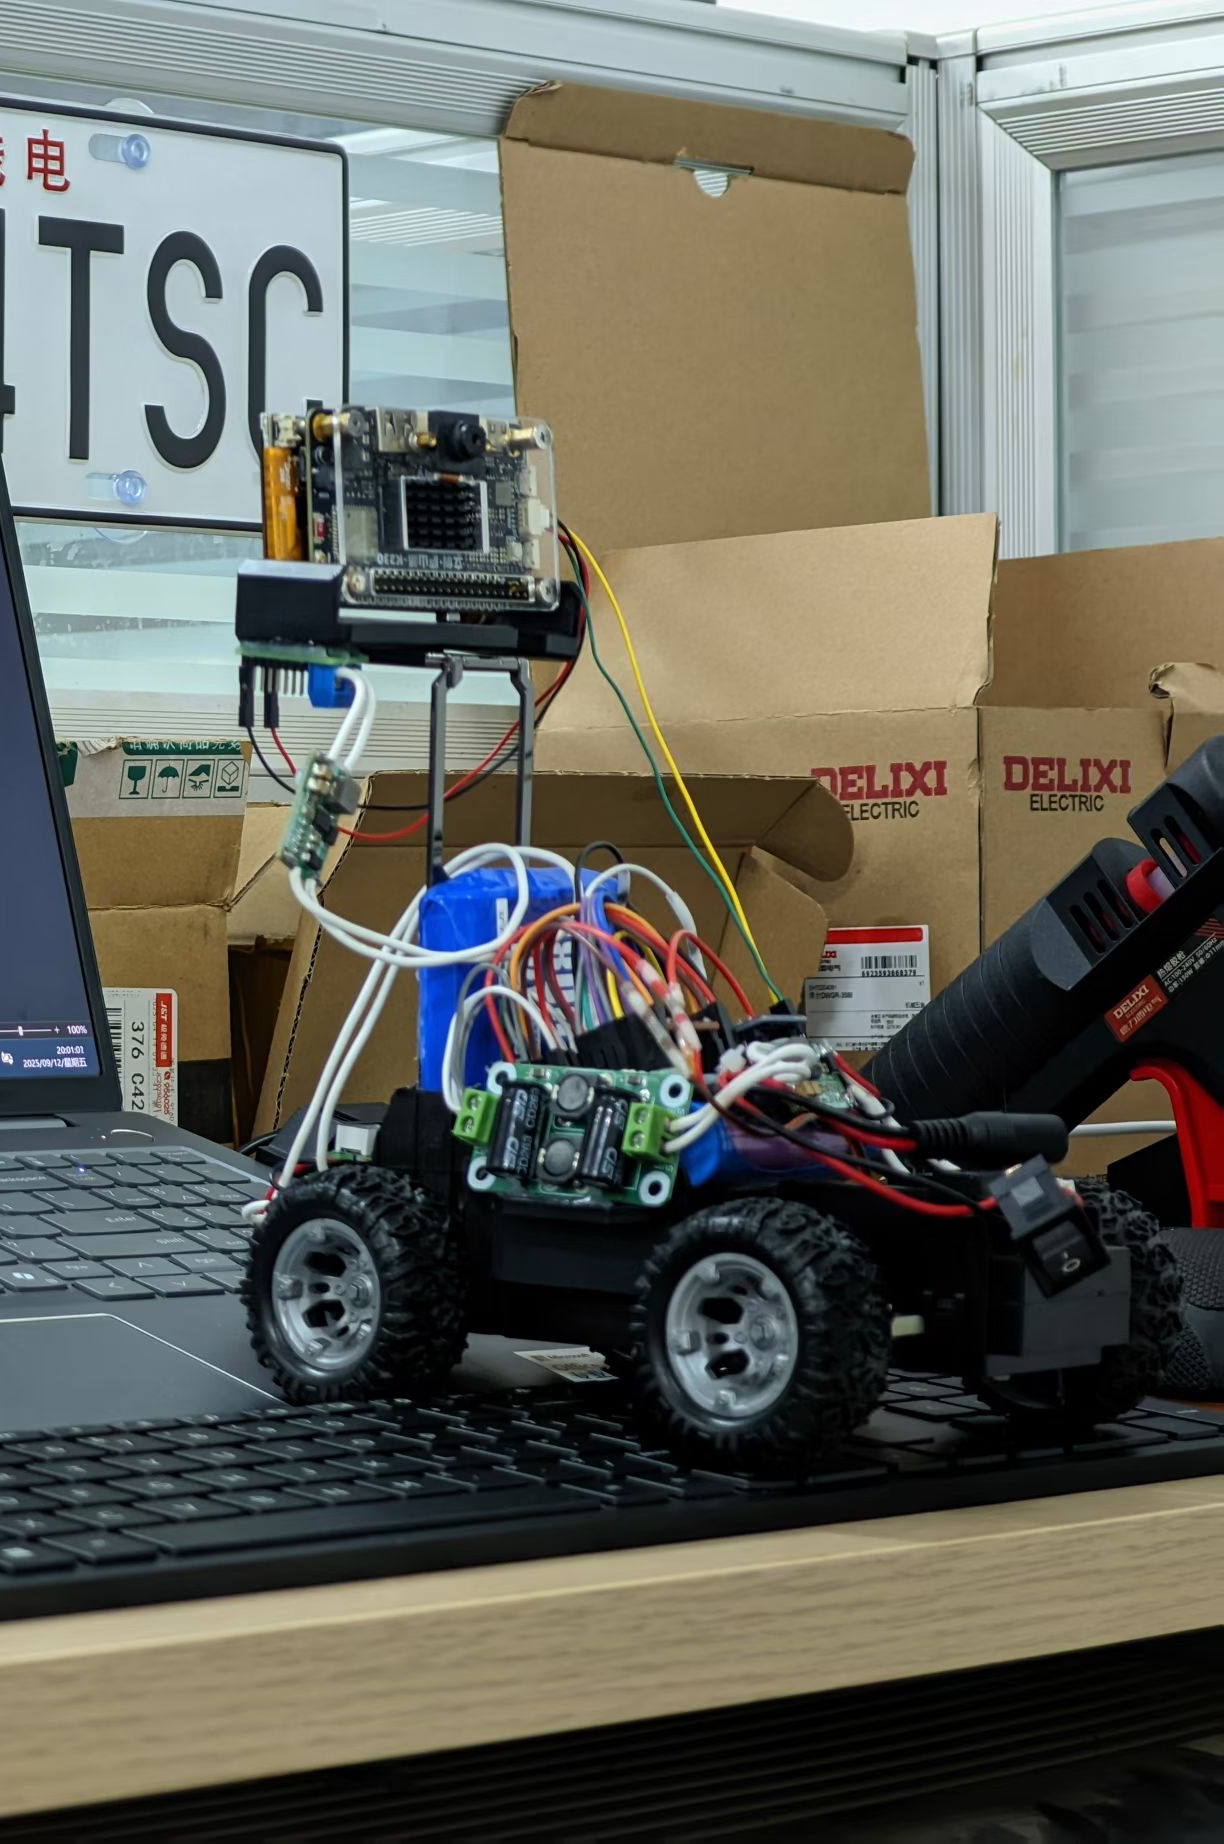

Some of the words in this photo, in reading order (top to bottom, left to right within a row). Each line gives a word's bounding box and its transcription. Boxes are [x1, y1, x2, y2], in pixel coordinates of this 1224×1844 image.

[811, 760, 948, 801] DELIXI
[1003, 755, 1132, 794] DELIXI
[1030, 794, 1105, 812] ELECTRIC
[1157, 950, 1186, 979] 热熔胶枪
[160, 1001, 168, 1021] J&T
[1113, 985, 1150, 1019] DELIXI
[67, 1024, 88, 1035] 100%
[131, 1021, 145, 1060] 376
[22, 1057, 88, 1069] 2025/09/12/星期五
[131, 1073, 145, 1110] C42
[163, 1082, 171, 1116] 956025
